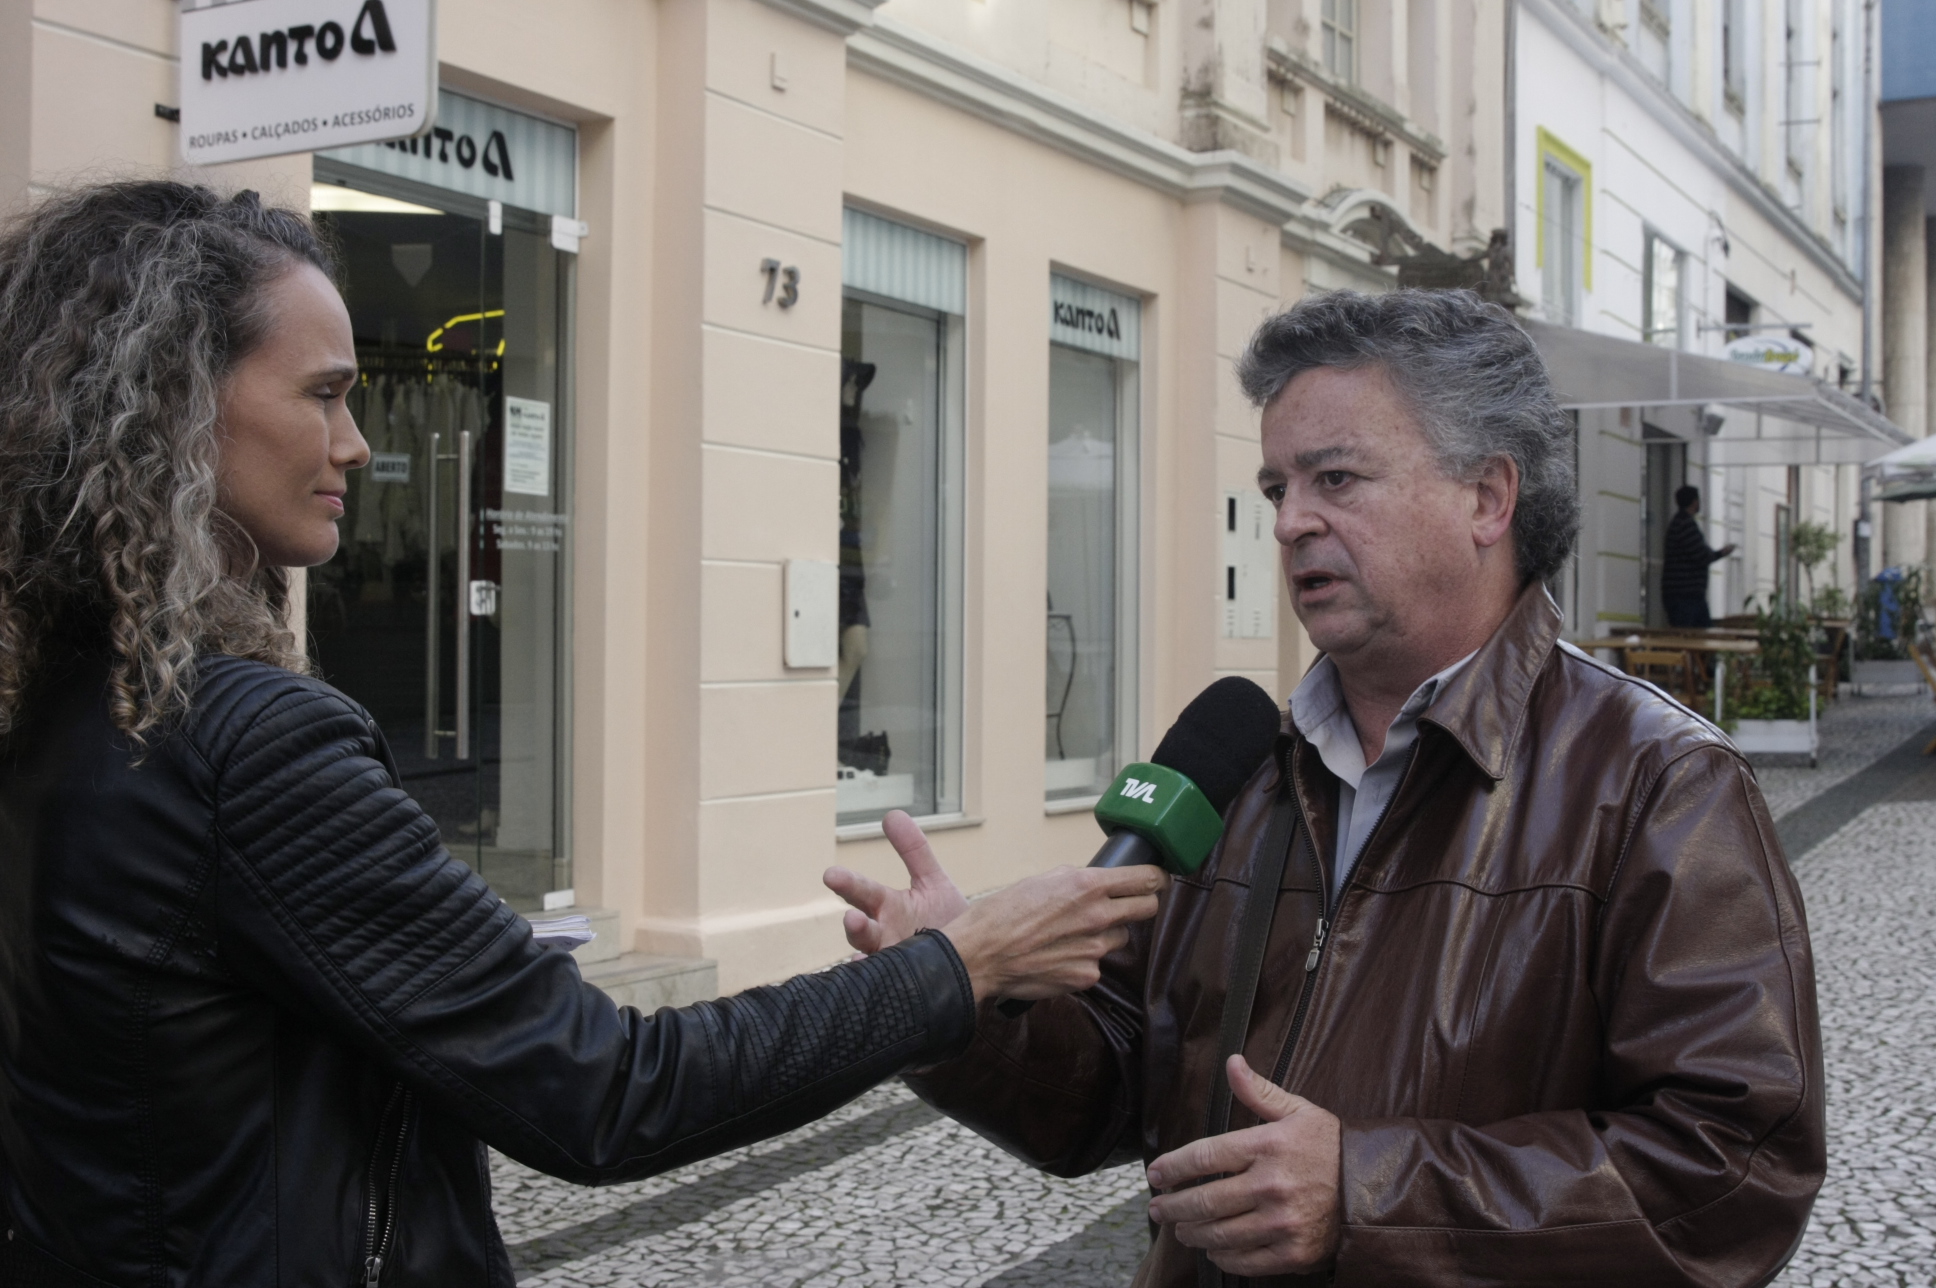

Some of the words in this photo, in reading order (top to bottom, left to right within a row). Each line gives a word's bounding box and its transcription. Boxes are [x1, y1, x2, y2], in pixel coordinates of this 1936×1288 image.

[189, 129, 239, 149] ROUPAS
[250, 117, 319, 140] CALÇADOS
[331, 103, 415, 128] ACESSÓRIOS
[760, 257, 801, 310] 73
